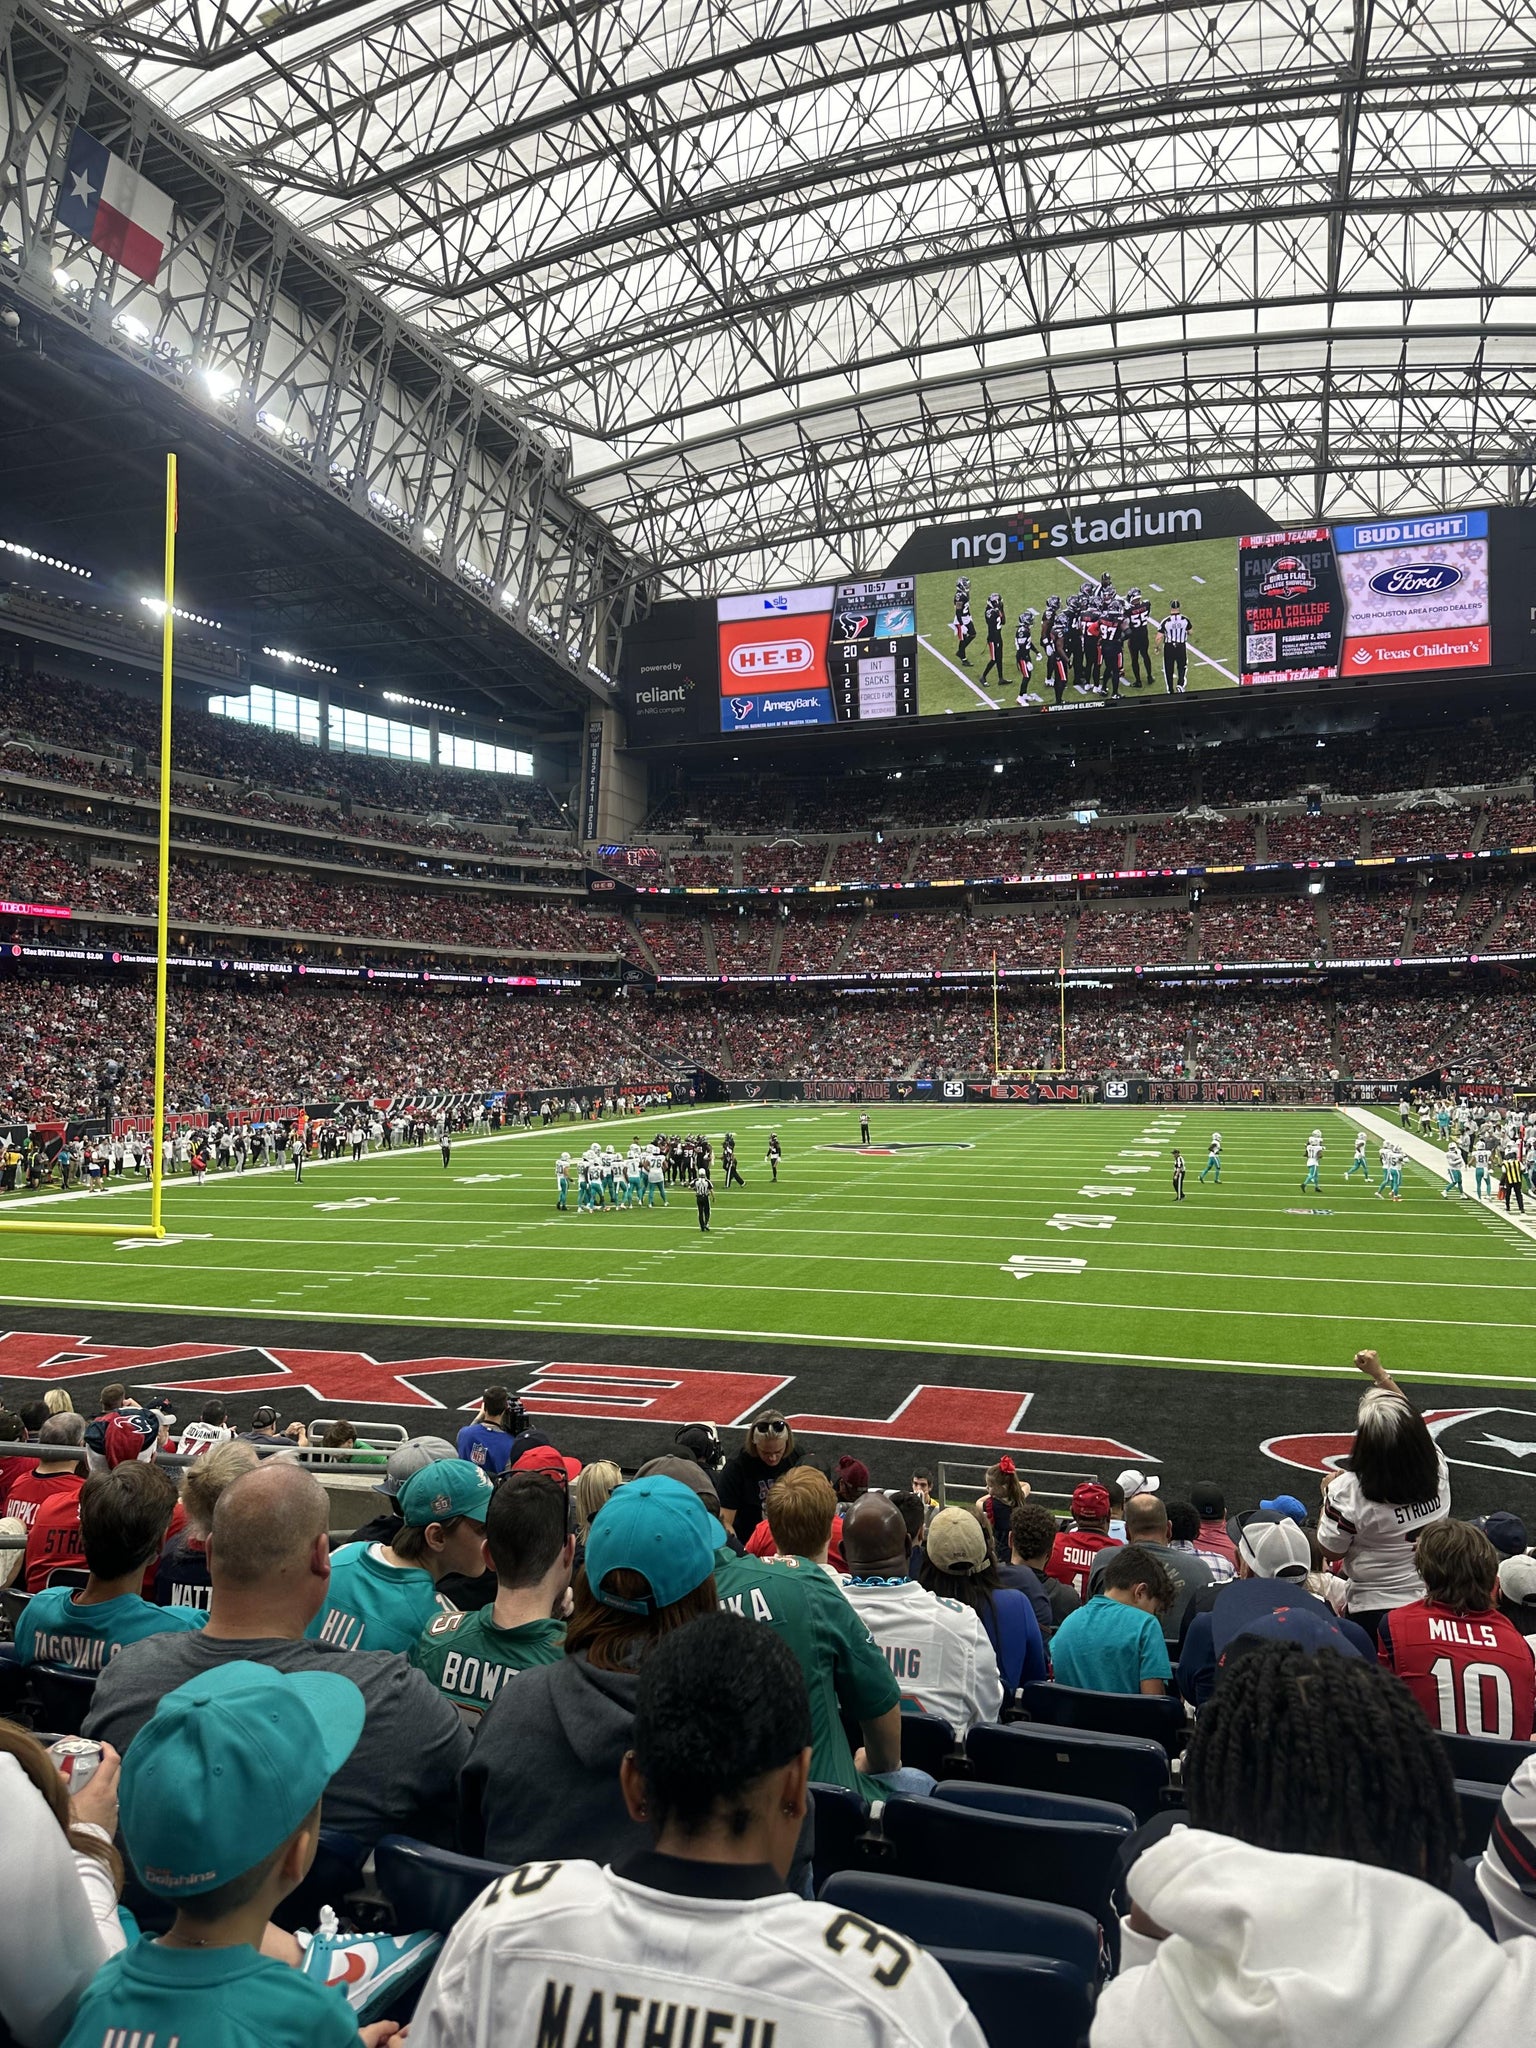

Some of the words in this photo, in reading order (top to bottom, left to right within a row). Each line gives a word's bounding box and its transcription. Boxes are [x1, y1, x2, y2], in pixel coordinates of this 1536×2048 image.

[951, 532, 1006, 564] nrg
[1050, 506, 1202, 547] stadium
[1250, 533, 1286, 545] HOUSTON
[1287, 529, 1318, 540] TEXANS
[1358, 526, 1401, 544] BUD
[1403, 519, 1463, 540] LIGHT
[864, 582, 886, 593] 10:57
[1387, 568, 1444, 592] Ford
[773, 595, 788, 606] slb
[1245, 607, 1273, 621] EARN
[1276, 606, 1282, 618] A
[1285, 602, 1330, 617] COLLEGE
[1371, 609, 1408, 618] HOUSTON
[1408, 607, 1427, 615] AREA
[1428, 605, 1449, 613] FORD
[1449, 602, 1482, 611] DEALERS
[1253, 614, 1324, 632] SCHOLARSHIP
[843, 645, 857, 658] 20
[889, 641, 897, 653] 6
[1375, 648, 1411, 661] Texas
[1412, 640, 1479, 658] Children's
[640, 662, 672, 674] powered
[673, 662, 682, 671] by
[870, 661, 882, 670] INT
[903, 657, 909, 667] 0
[844, 678, 851, 688] 2
[864, 675, 890, 686] SACKS
[903, 672, 910, 683] 2
[1252, 673, 1287, 684] HOUSTON
[1289, 670, 1320, 681] TEXANS
[636, 686, 686, 703] reliant
[845, 693, 851, 703] 2
[903, 688, 910, 698] 2
[1048, 703, 1078, 712] MITSUBISHI
[1079, 701, 1105, 709] ELECTRIC
[37, 949, 65, 957] BOTTLED
[65, 950, 85, 959] WATER
[233, 962, 249, 970] FAN
[249, 963, 270, 971] FIRST
[269, 964, 292, 973] DEALS
[620, 1084, 669, 1095] HOUSTON
[946, 1083, 961, 1096] 25
[967, 1084, 1100, 1100] TEXAN
[1108, 1083, 1126, 1096] 25
[1458, 1084, 1503, 1095] HOUSTON
[111, 1112, 209, 1138] HOUTON
[650, 1158, 662, 1168] 76
[1394, 1496, 1442, 1524] STROUD
[1428, 1617, 1498, 1648] MILLS
[1430, 1657, 1514, 1741] 10
